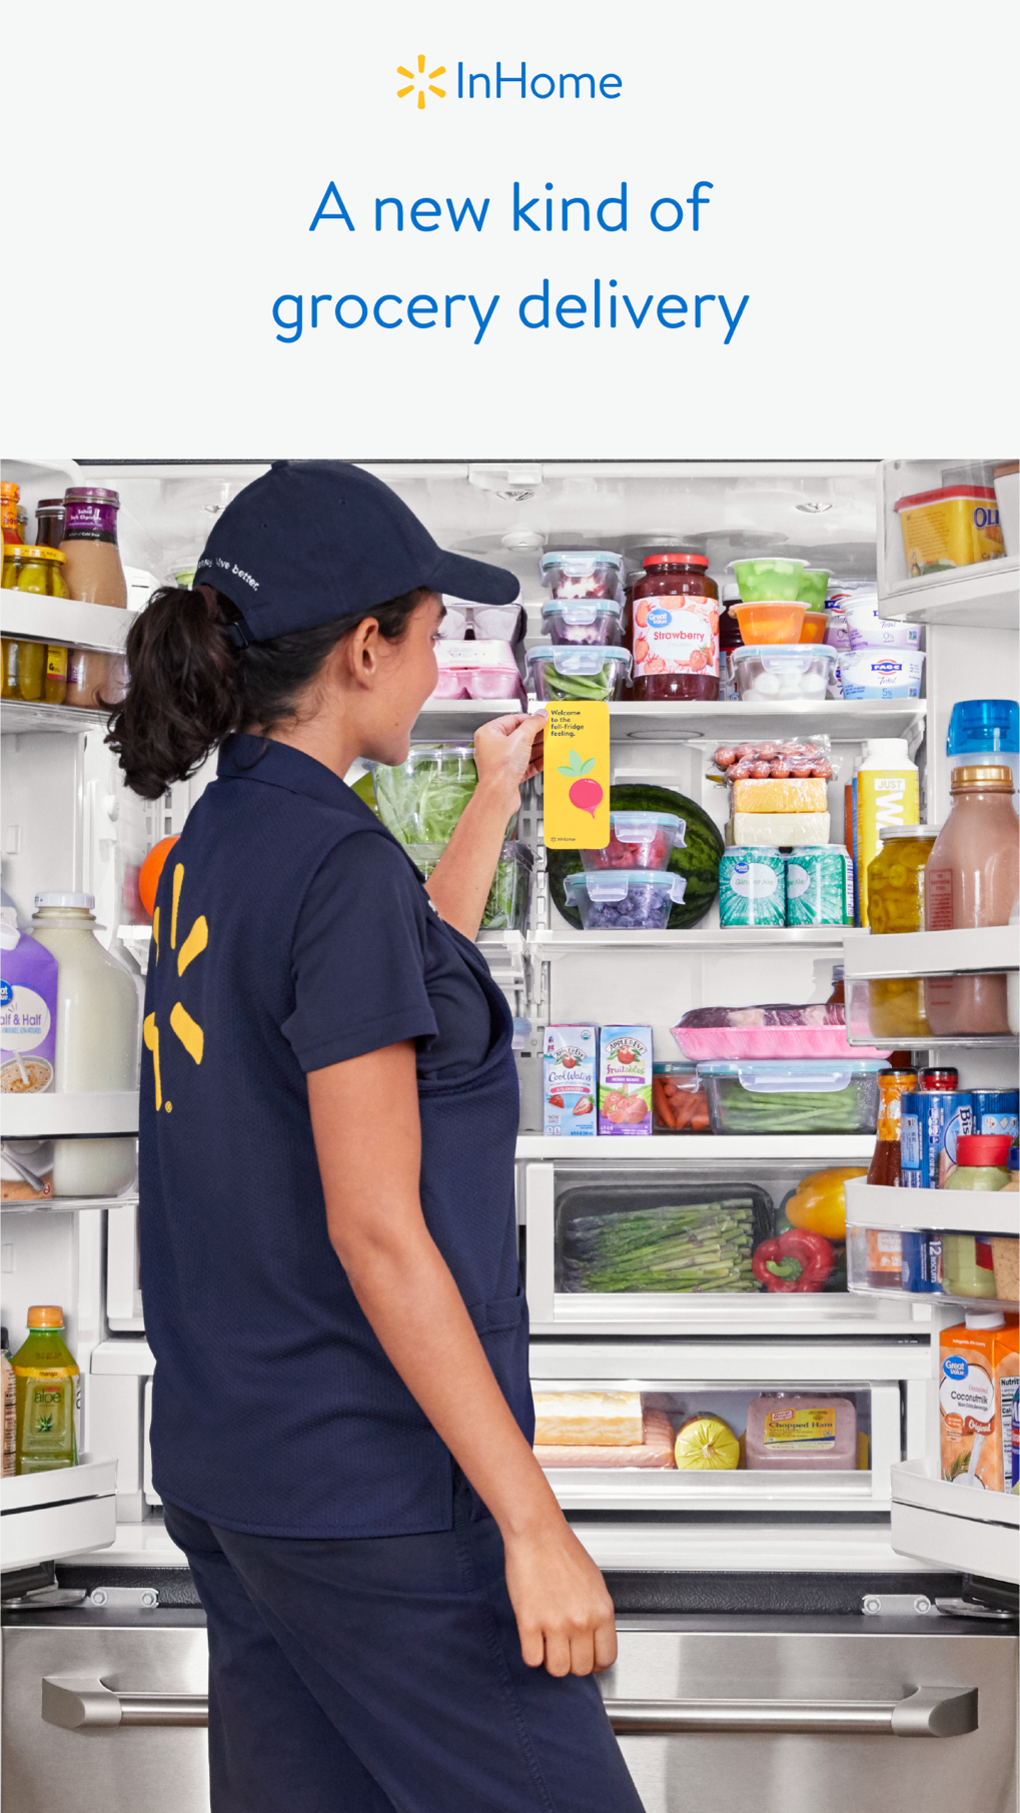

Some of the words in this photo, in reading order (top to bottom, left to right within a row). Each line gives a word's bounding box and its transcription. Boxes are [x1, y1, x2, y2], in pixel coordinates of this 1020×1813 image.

[231, 563, 260, 592] better.
[648, 612, 668, 621] Great
[653, 630, 705, 642] Strawberry
[550, 723, 585, 731] full-fridge
[550, 730, 576, 739] feeling.
[877, 780, 903, 789] JUST
[13, 1013, 21, 1026] &
[22, 1013, 42, 1026] Half
[606, 1063, 646, 1075] fruitables
[929, 1241, 942, 1256] 12
[945, 1360, 965, 1371] Great
[949, 1367, 965, 1376] Value
[33, 1388, 61, 1404] aloe
[950, 1390, 988, 1405] Coconutmilk
[769, 1421, 809, 1430] Chopped
[968, 1418, 992, 1433] Original
